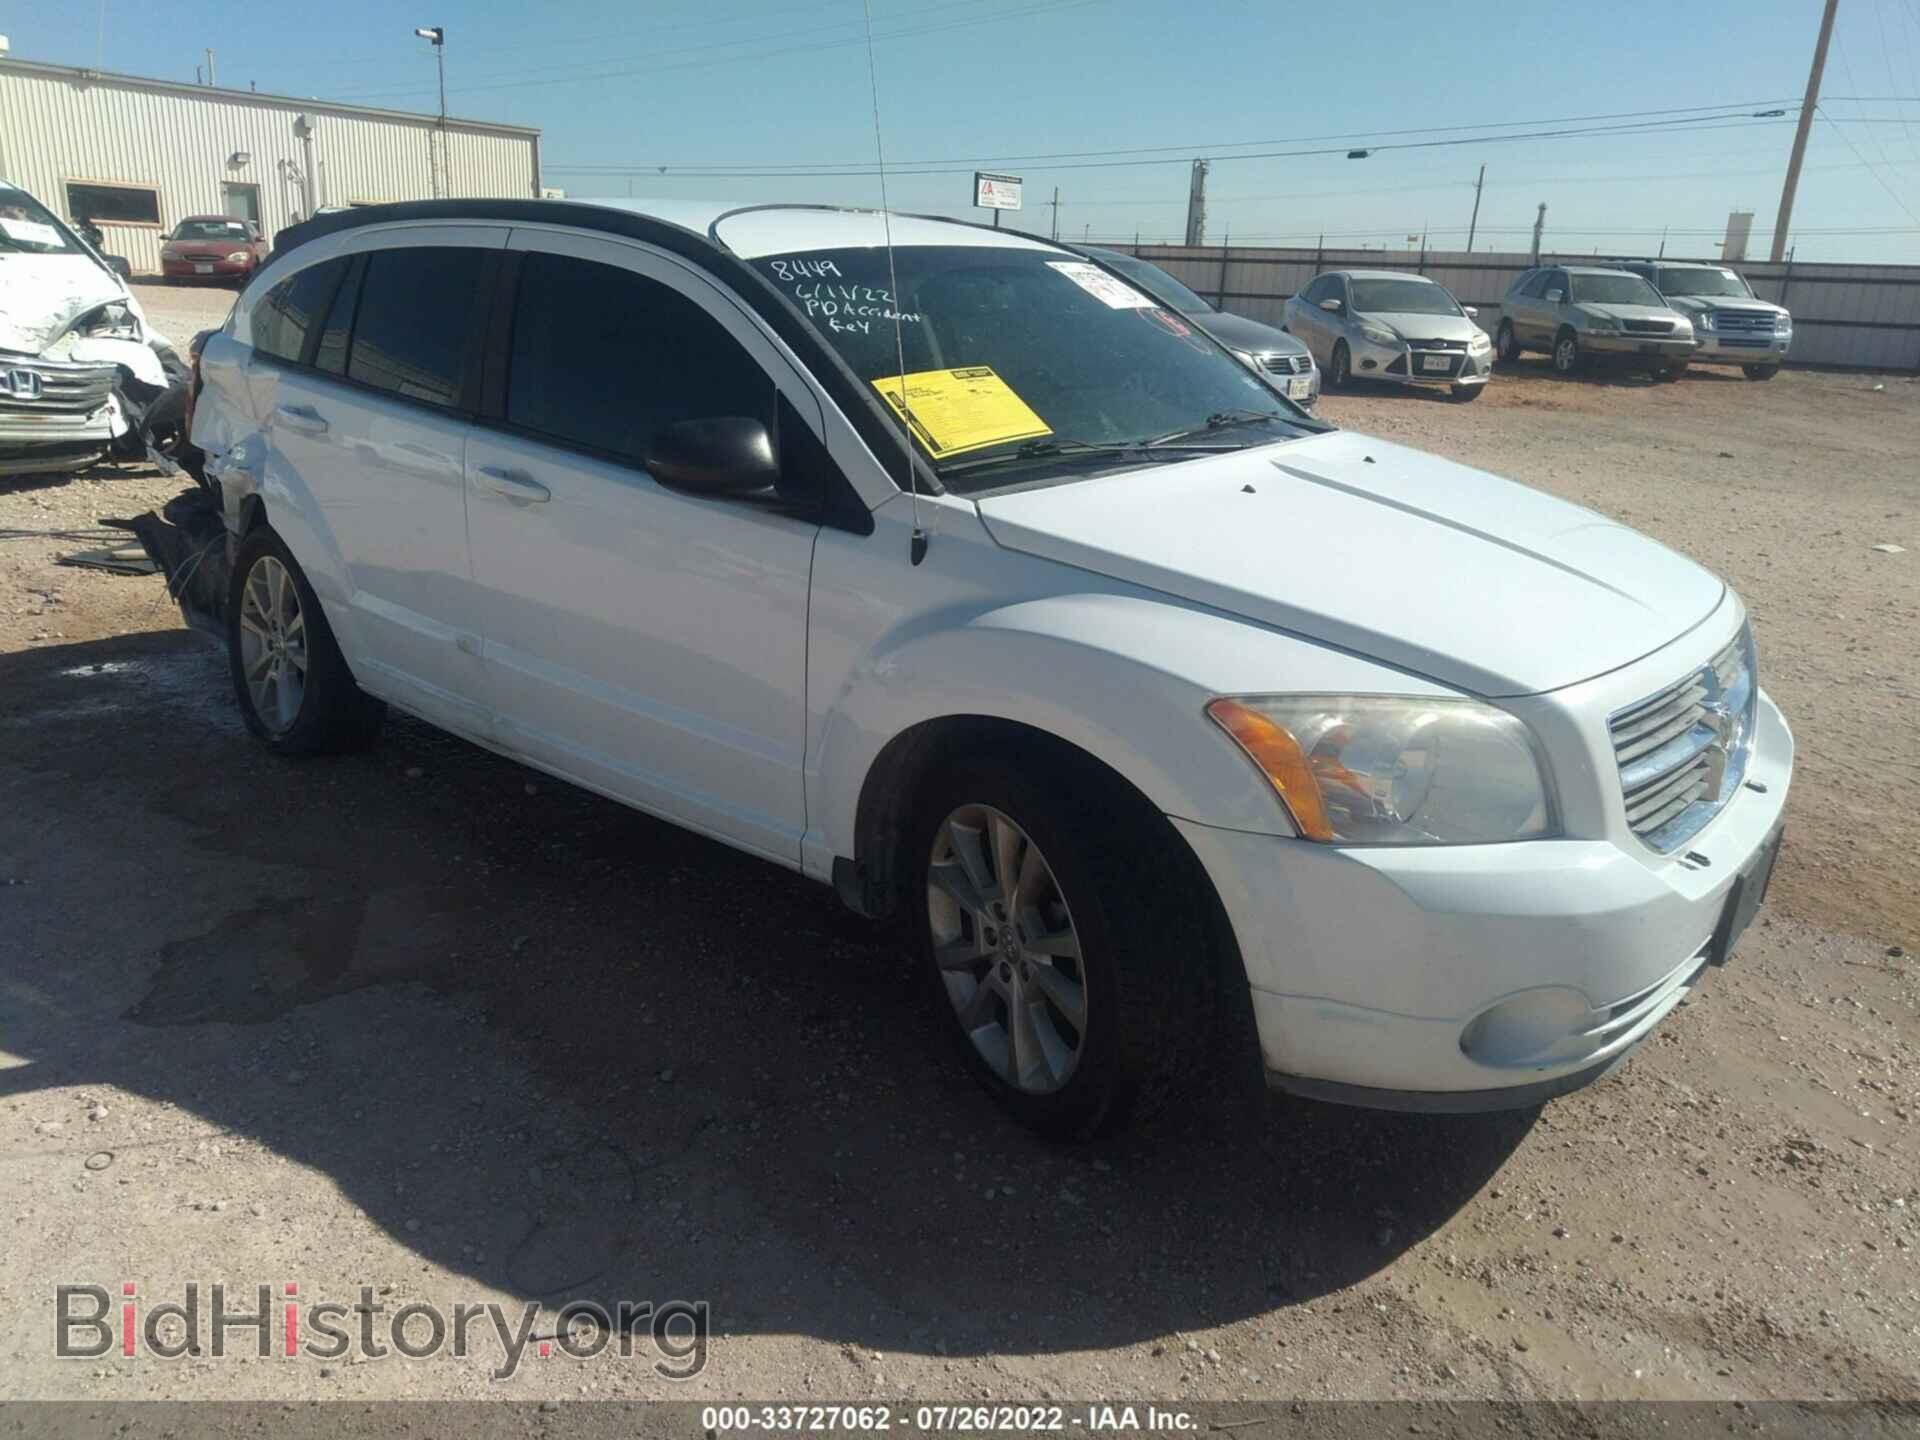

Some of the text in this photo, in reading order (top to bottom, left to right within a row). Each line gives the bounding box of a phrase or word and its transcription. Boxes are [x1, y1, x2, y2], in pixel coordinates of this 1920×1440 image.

[770, 260, 842, 281] 8449
[804, 299, 921, 323] PD Accident
